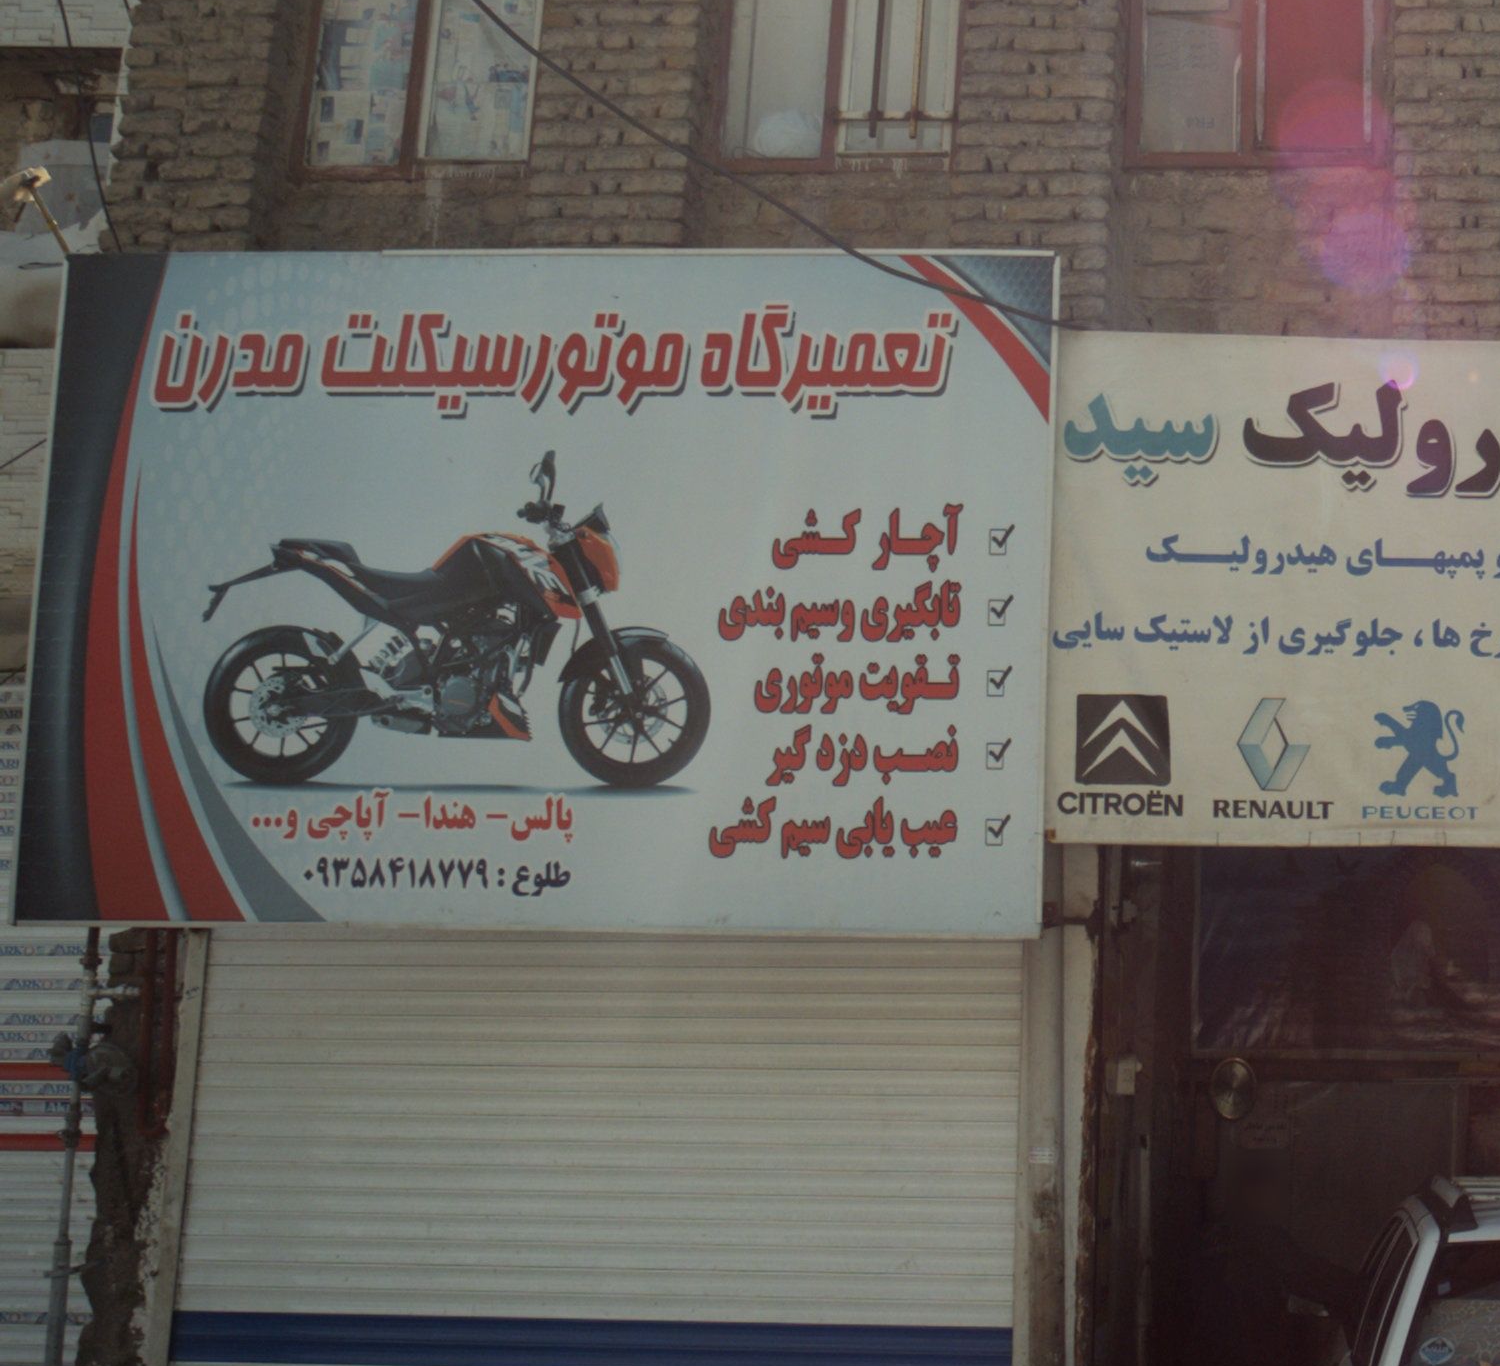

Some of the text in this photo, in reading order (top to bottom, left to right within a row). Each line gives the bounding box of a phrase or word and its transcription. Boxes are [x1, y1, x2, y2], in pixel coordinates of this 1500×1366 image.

[153, 312, 309, 411] مدرن
[701, 304, 955, 417] تعمیرگاه
[1063, 392, 1218, 486] سید
[772, 503, 963, 572] آچار کشی
[1145, 534, 1337, 575] هیدرولیک
[1346, 538, 1485, 581] پمپهای
[718, 586, 785, 641] بندی
[1052, 611, 1125, 649] سایی
[1133, 614, 1234, 651] لاستیک
[1243, 616, 1270, 655] از
[1278, 618, 1403, 657] جلوگیری
[755, 653, 960, 714] تقویت موتوری
[873, 724, 958, 785] نصب
[307, 791, 389, 841] آپاچی
[1057, 789, 1184, 818] CITROËN
[1212, 799, 1334, 821] RENAULT
[1362, 805, 1480, 821] PEUGEOT
[709, 796, 958, 859] عیب یابی سیم کشی
[303, 856, 488, 888] ۰۹۳۵۸۴۱۸۷۷۹
